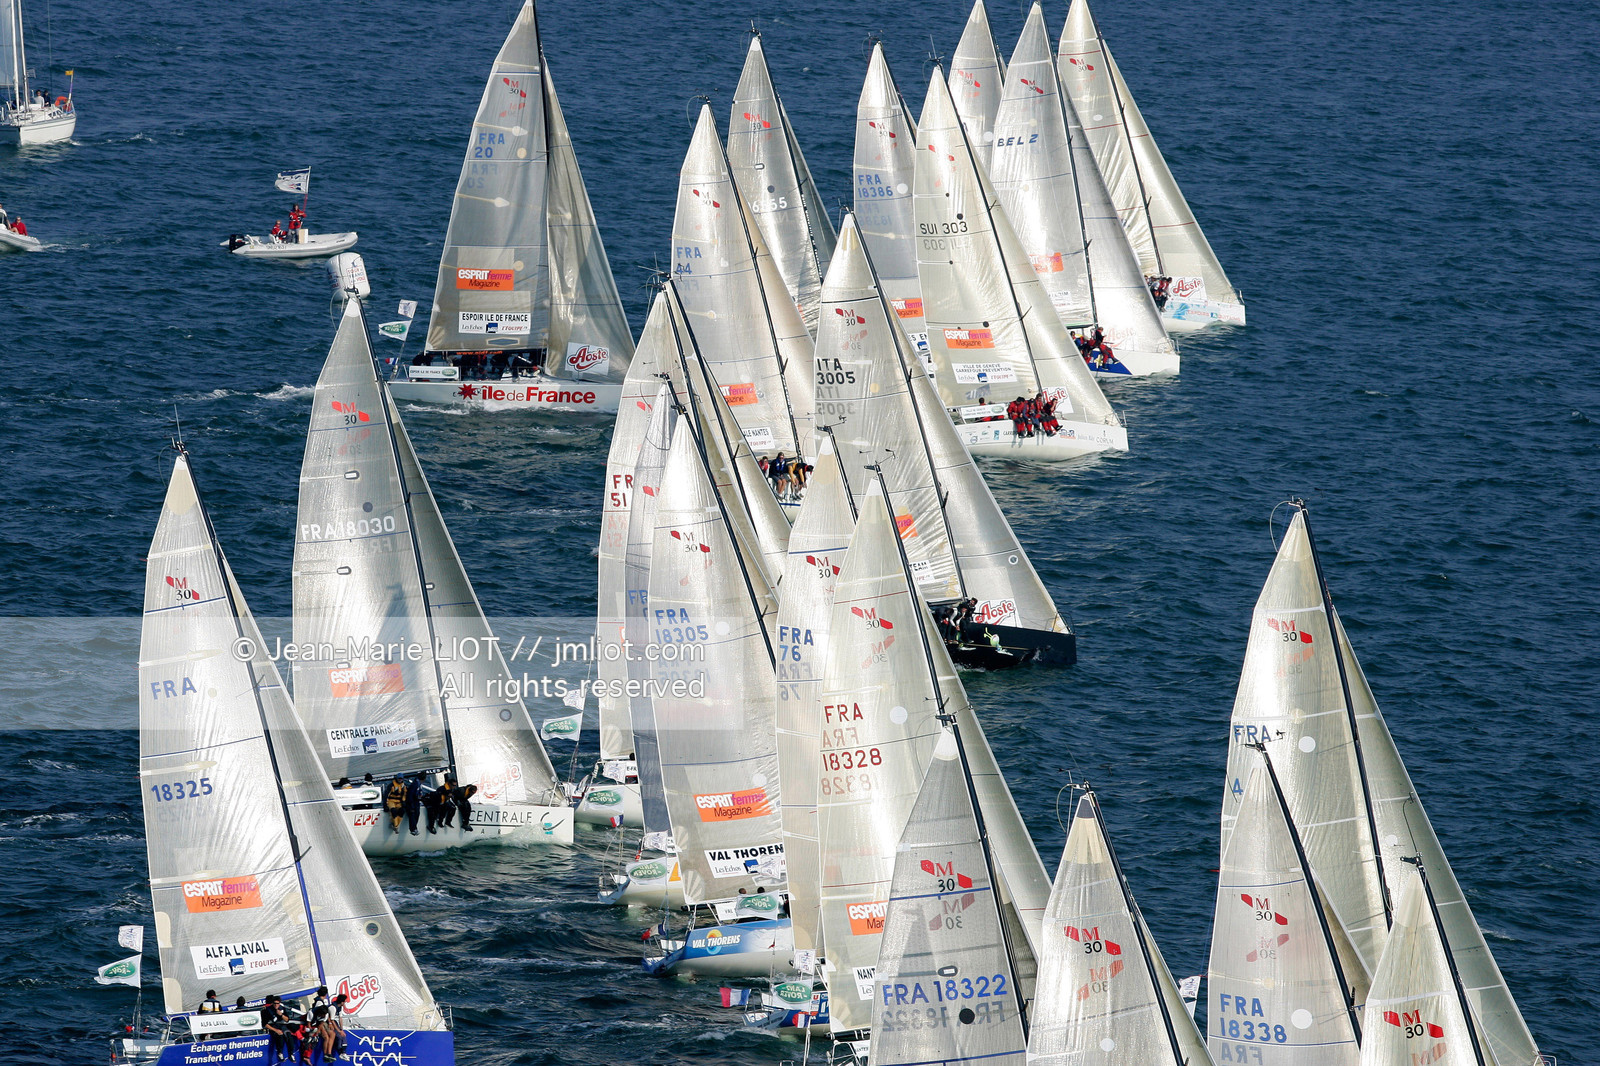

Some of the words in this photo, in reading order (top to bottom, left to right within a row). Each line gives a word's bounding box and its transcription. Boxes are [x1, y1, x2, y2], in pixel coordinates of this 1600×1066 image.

[479, 133, 505, 145] FRA
[997, 137, 1024, 147] BEL
[474, 147, 493, 158] 20
[858, 174, 882, 185] FRA
[858, 186, 893, 198] 18386
[752, 196, 787, 212] 655
[920, 224, 938, 235] SUI
[942, 222, 968, 233] 303
[676, 247, 702, 259] FRA
[676, 263, 692, 275] 44
[469, 280, 500, 288] Magazine
[462, 313, 483, 321] ESPOIR
[496, 314, 504, 322] DE
[504, 314, 528, 322] FRANCE
[844, 310, 855, 318] M
[956, 339, 982, 347] Magazine
[570, 348, 608, 368] Aoste
[817, 358, 842, 371] ITA
[816, 372, 856, 386] 3005
[482, 386, 505, 401] île
[506, 390, 525, 401] de
[526, 386, 596, 404] France
[343, 402, 356, 413] M
[344, 414, 357, 425] 30
[613, 475, 633, 490] FR
[610, 493, 627, 507] 51
[301, 523, 335, 541] FRA
[685, 544, 698, 552] 30
[817, 556, 830, 568] M
[818, 568, 830, 578] 30
[175, 577, 188, 589] M
[176, 589, 192, 601] 30
[655, 608, 690, 626] FRA
[864, 608, 878, 620] M
[976, 601, 1014, 622] Aoste
[866, 620, 880, 630] 30
[1282, 620, 1296, 632] M
[656, 625, 708, 644] 18305
[779, 626, 814, 646] FRA
[1282, 632, 1298, 642] 30
[779, 645, 802, 662] 76
[151, 677, 197, 700] FRA
[824, 702, 864, 724] FRA
[331, 728, 368, 740] CENTRALE
[1234, 725, 1272, 743] FRA
[822, 748, 882, 772] 18328
[151, 778, 213, 802] 18325
[1233, 778, 1244, 796] 4
[469, 810, 532, 824] CENTRALE
[714, 806, 752, 818] Magazine
[709, 850, 731, 862] VAL
[734, 844, 784, 860] THOREN
[936, 862, 954, 876] M
[938, 878, 955, 892] 30
[202, 895, 242, 909] Magazine
[1256, 898, 1270, 910] M
[1256, 911, 1272, 921] 30
[692, 939, 706, 948] VAL
[707, 934, 741, 946] THORENS
[1082, 926, 1100, 942] M
[206, 946, 232, 958] ALFA
[234, 942, 270, 956] LAVAL
[1084, 941, 1102, 954] 30
[332, 976, 379, 1003] Aoste
[883, 982, 930, 1006] FRA
[934, 974, 1008, 1002] 18322
[1220, 993, 1264, 1017] FRA
[200, 1020, 212, 1028] ALFA
[1403, 1009, 1421, 1027] M
[1220, 1018, 1288, 1044] 18338
[1405, 1024, 1424, 1039] 30
[191, 1043, 228, 1054] Échange
[229, 1038, 270, 1051] thermique
[359, 1036, 402, 1052] ALFA
[184, 1055, 224, 1064] Transfert
[224, 1054, 234, 1062] de
[236, 1050, 264, 1060] fluides
